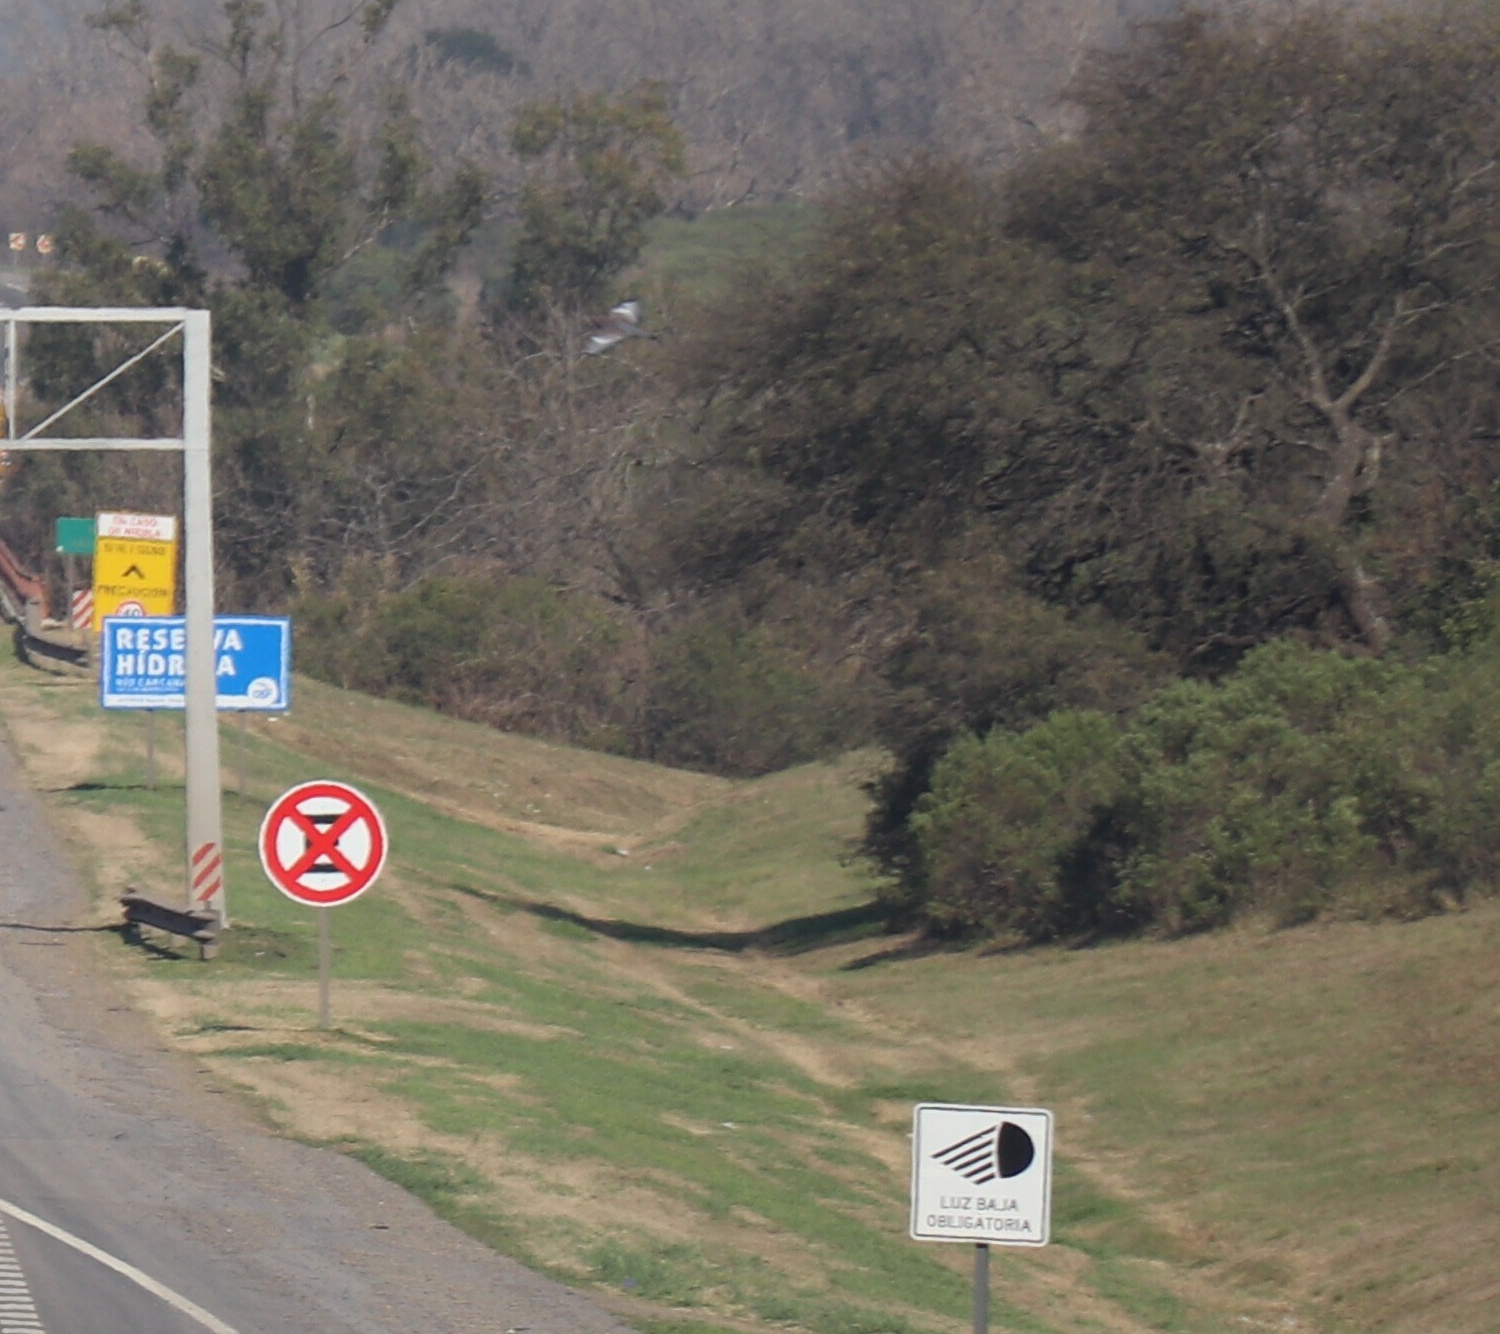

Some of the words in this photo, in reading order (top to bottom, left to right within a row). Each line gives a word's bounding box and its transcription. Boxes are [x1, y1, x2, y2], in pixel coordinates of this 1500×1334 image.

[116, 628, 243, 652] RESEVA
[116, 650, 237, 676] HÍDRA
[939, 1195, 972, 1211] LUZ
[976, 1196, 1019, 1212] BAJA
[926, 1214, 1032, 1234] OBLIGATORIA
